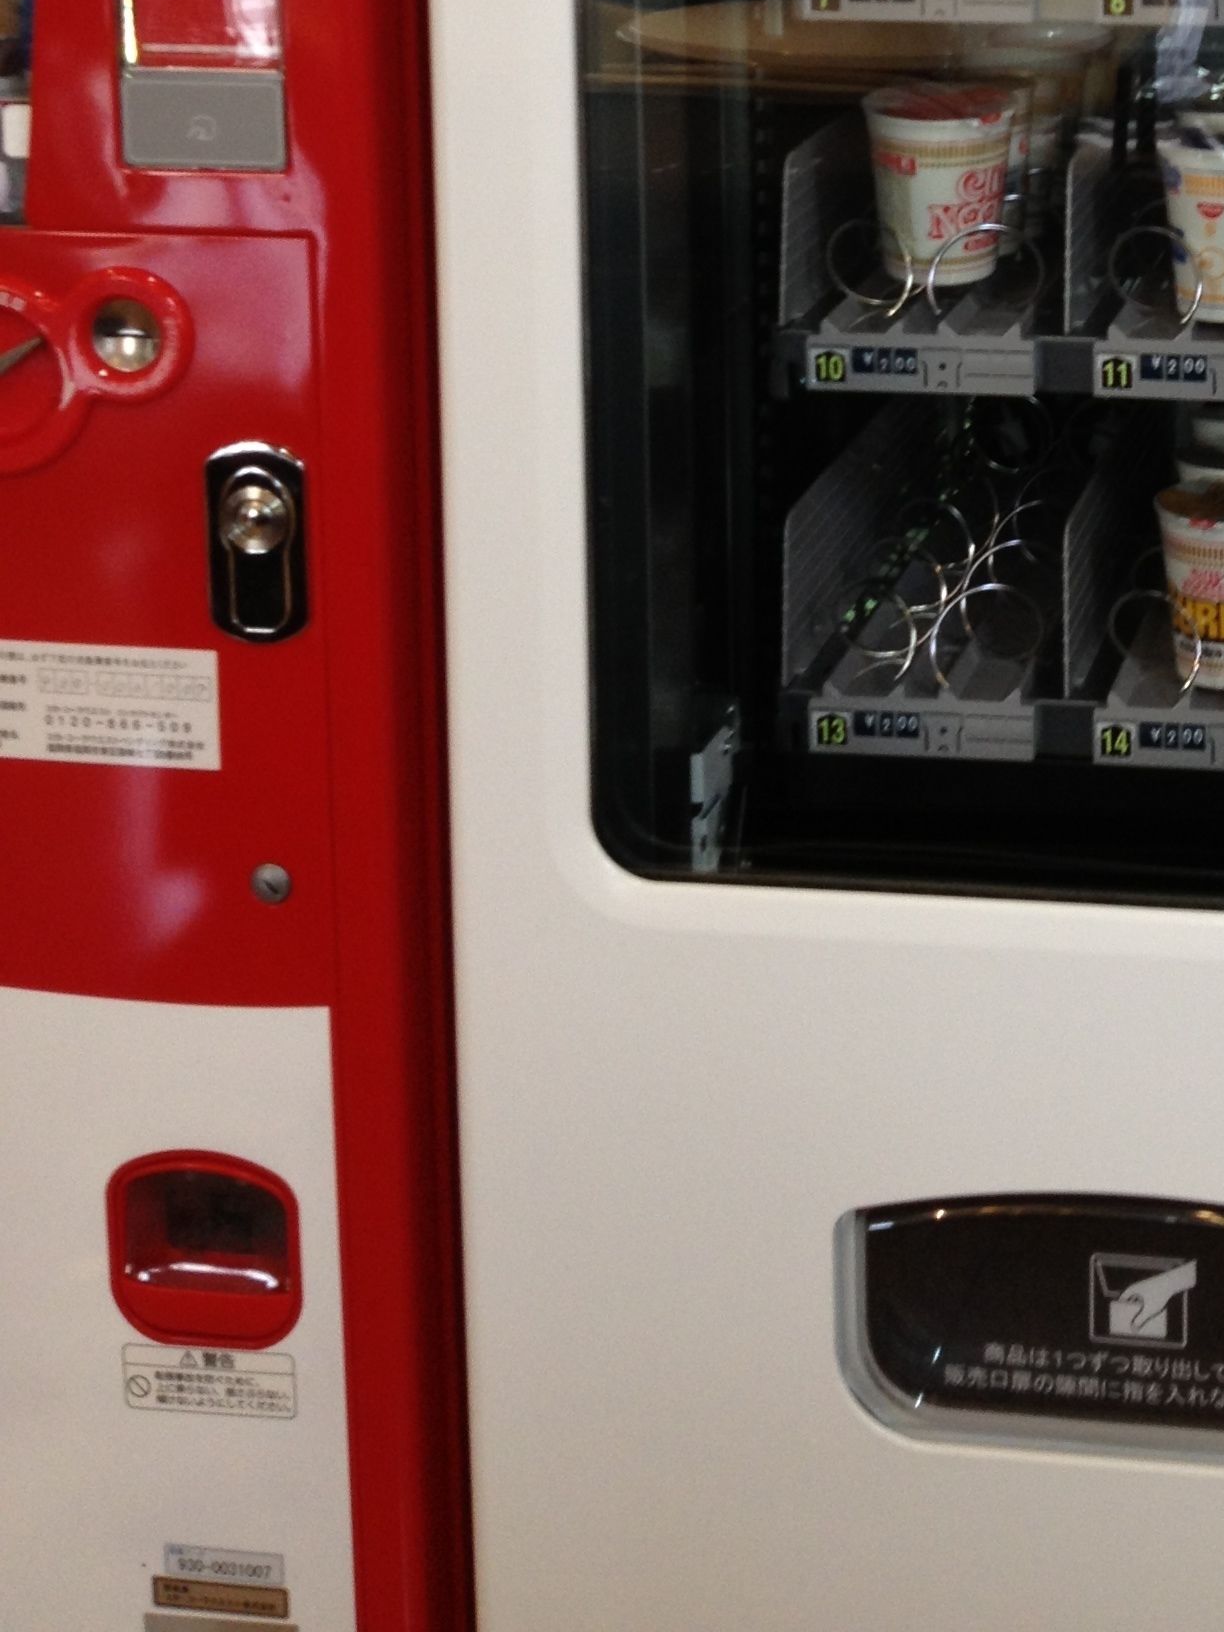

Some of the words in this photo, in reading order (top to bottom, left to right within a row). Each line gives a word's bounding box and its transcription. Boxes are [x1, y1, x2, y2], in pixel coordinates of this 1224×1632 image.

[815, 352, 845, 380] 10
[1102, 359, 1131, 387] 11
[1150, 354, 1206, 375] ¥200
[817, 716, 846, 744] 13
[1101, 728, 1130, 756] 14
[1149, 724, 1203, 745] ¥200
